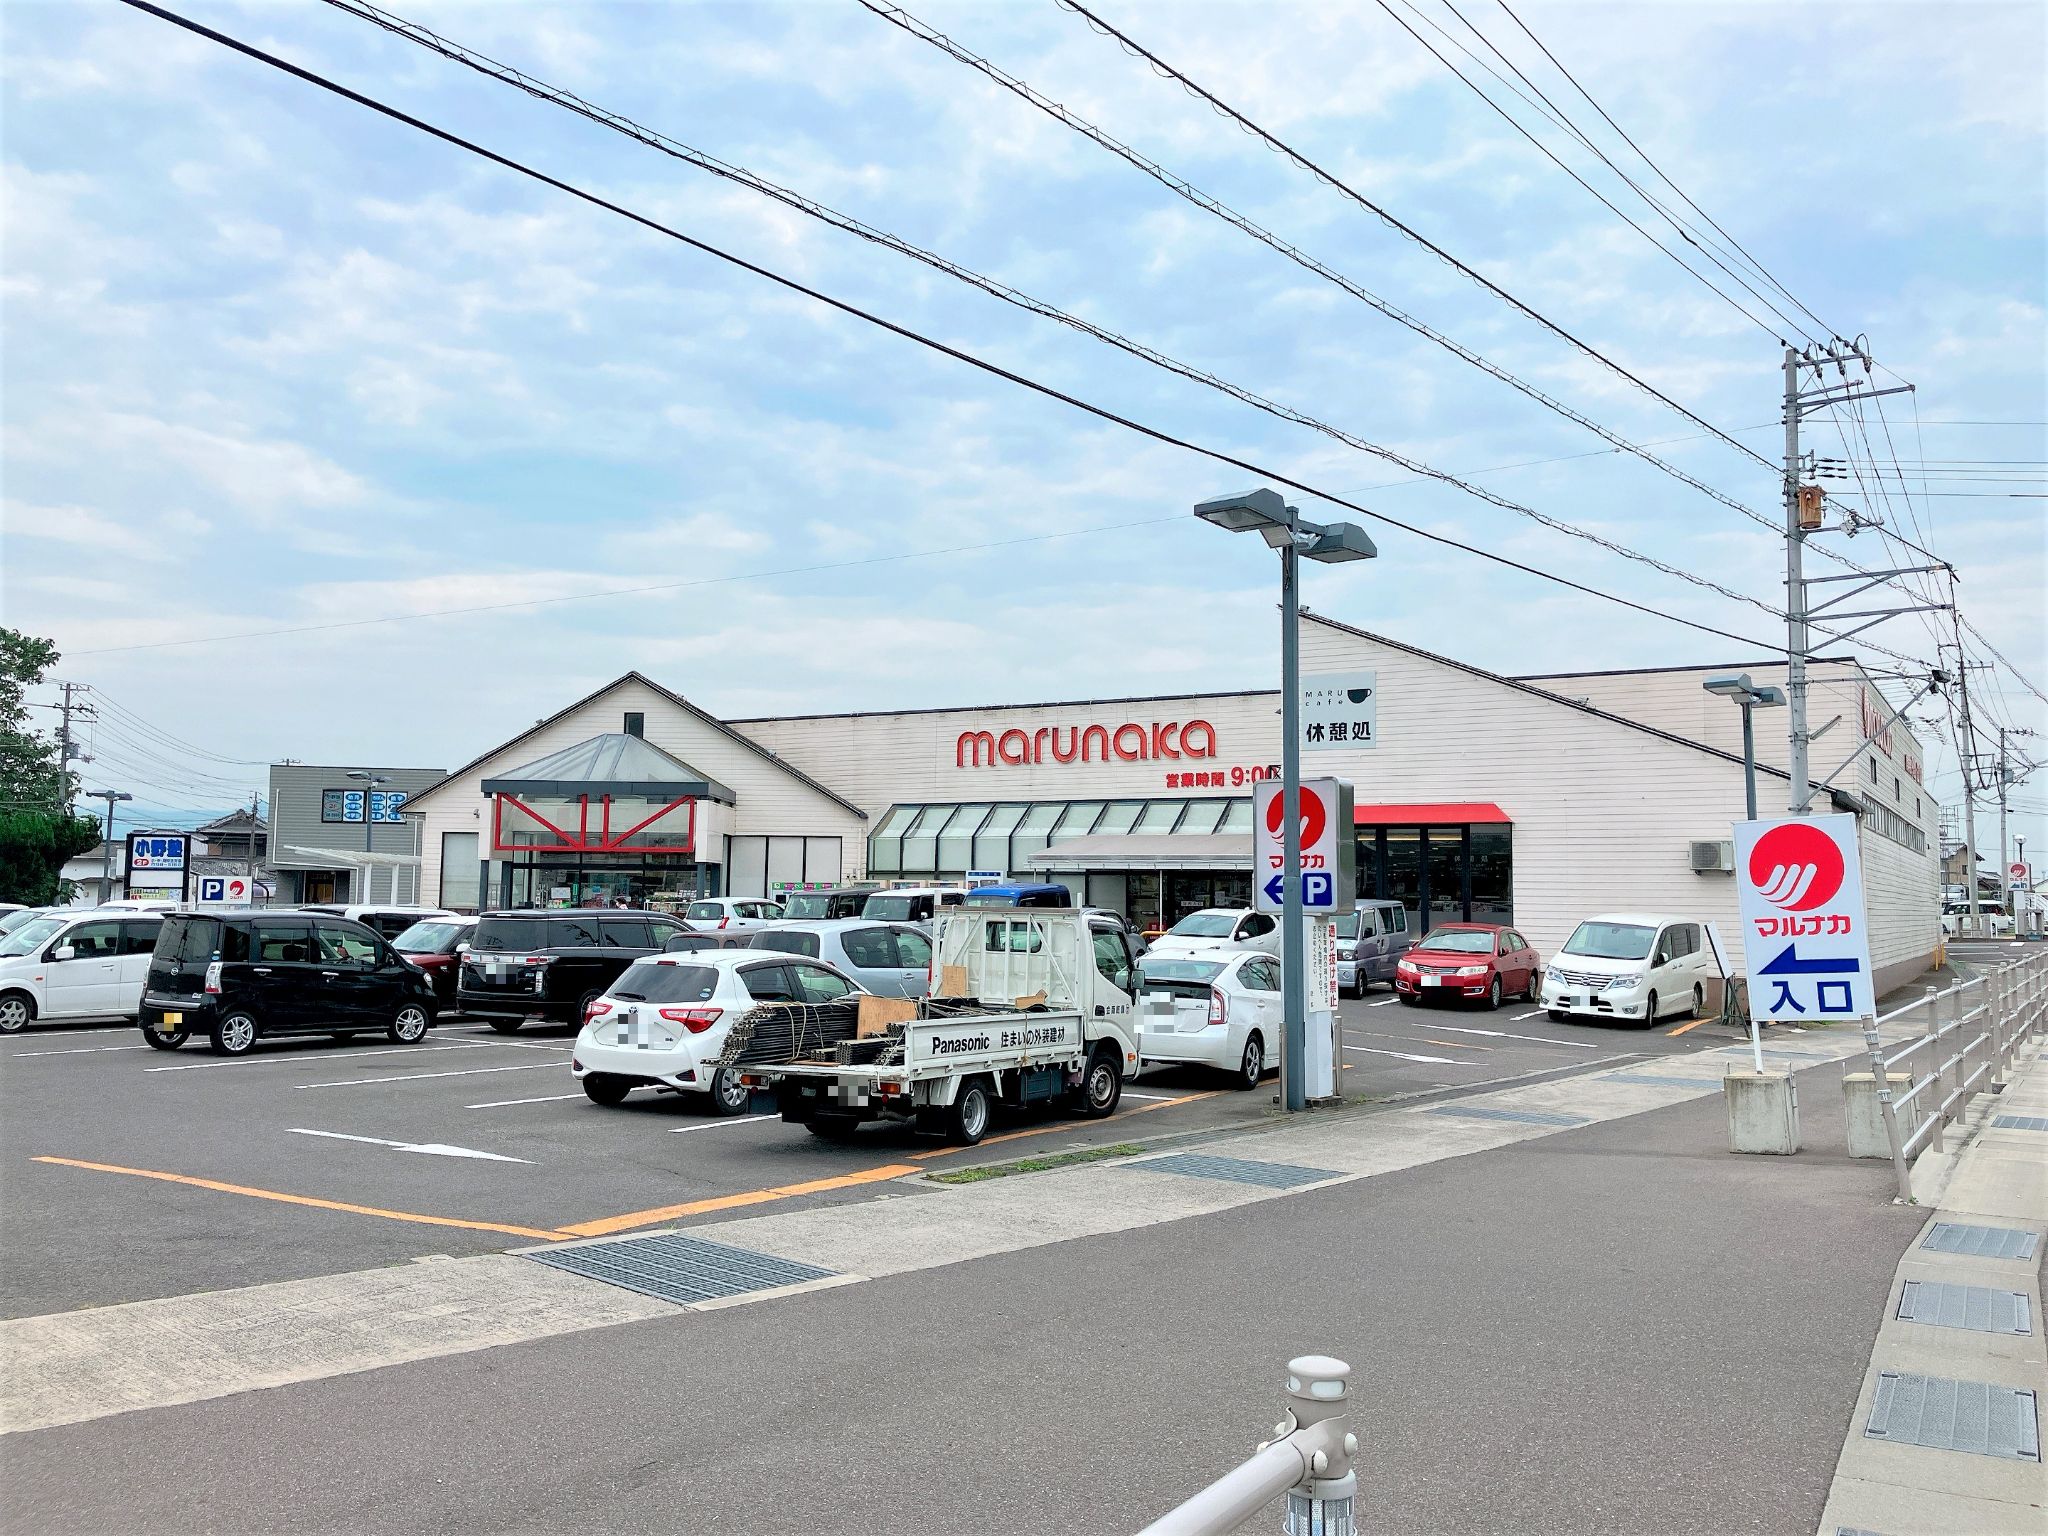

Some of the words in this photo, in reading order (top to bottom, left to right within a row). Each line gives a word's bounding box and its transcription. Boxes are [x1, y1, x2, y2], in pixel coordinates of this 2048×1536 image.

[1305, 690, 1343, 698] MARU
[1305, 699, 1343, 707] cafe
[1306, 721, 1371, 742] 休憩処
[956, 719, 1217, 767] marunaka
[1166, 772, 1225, 788] 営業時間
[1268, 854, 1325, 869] マナカ
[205, 881, 220, 899] P
[1307, 876, 1328, 904] P
[1754, 914, 1852, 937] マルナカ
[1328, 924, 1338, 1008] 通り抜け禁止
[1769, 980, 1854, 1014] 入口
[932, 1033, 990, 1055] Panasonic
[1000, 1026, 1065, 1048] 住まいの外装建材
